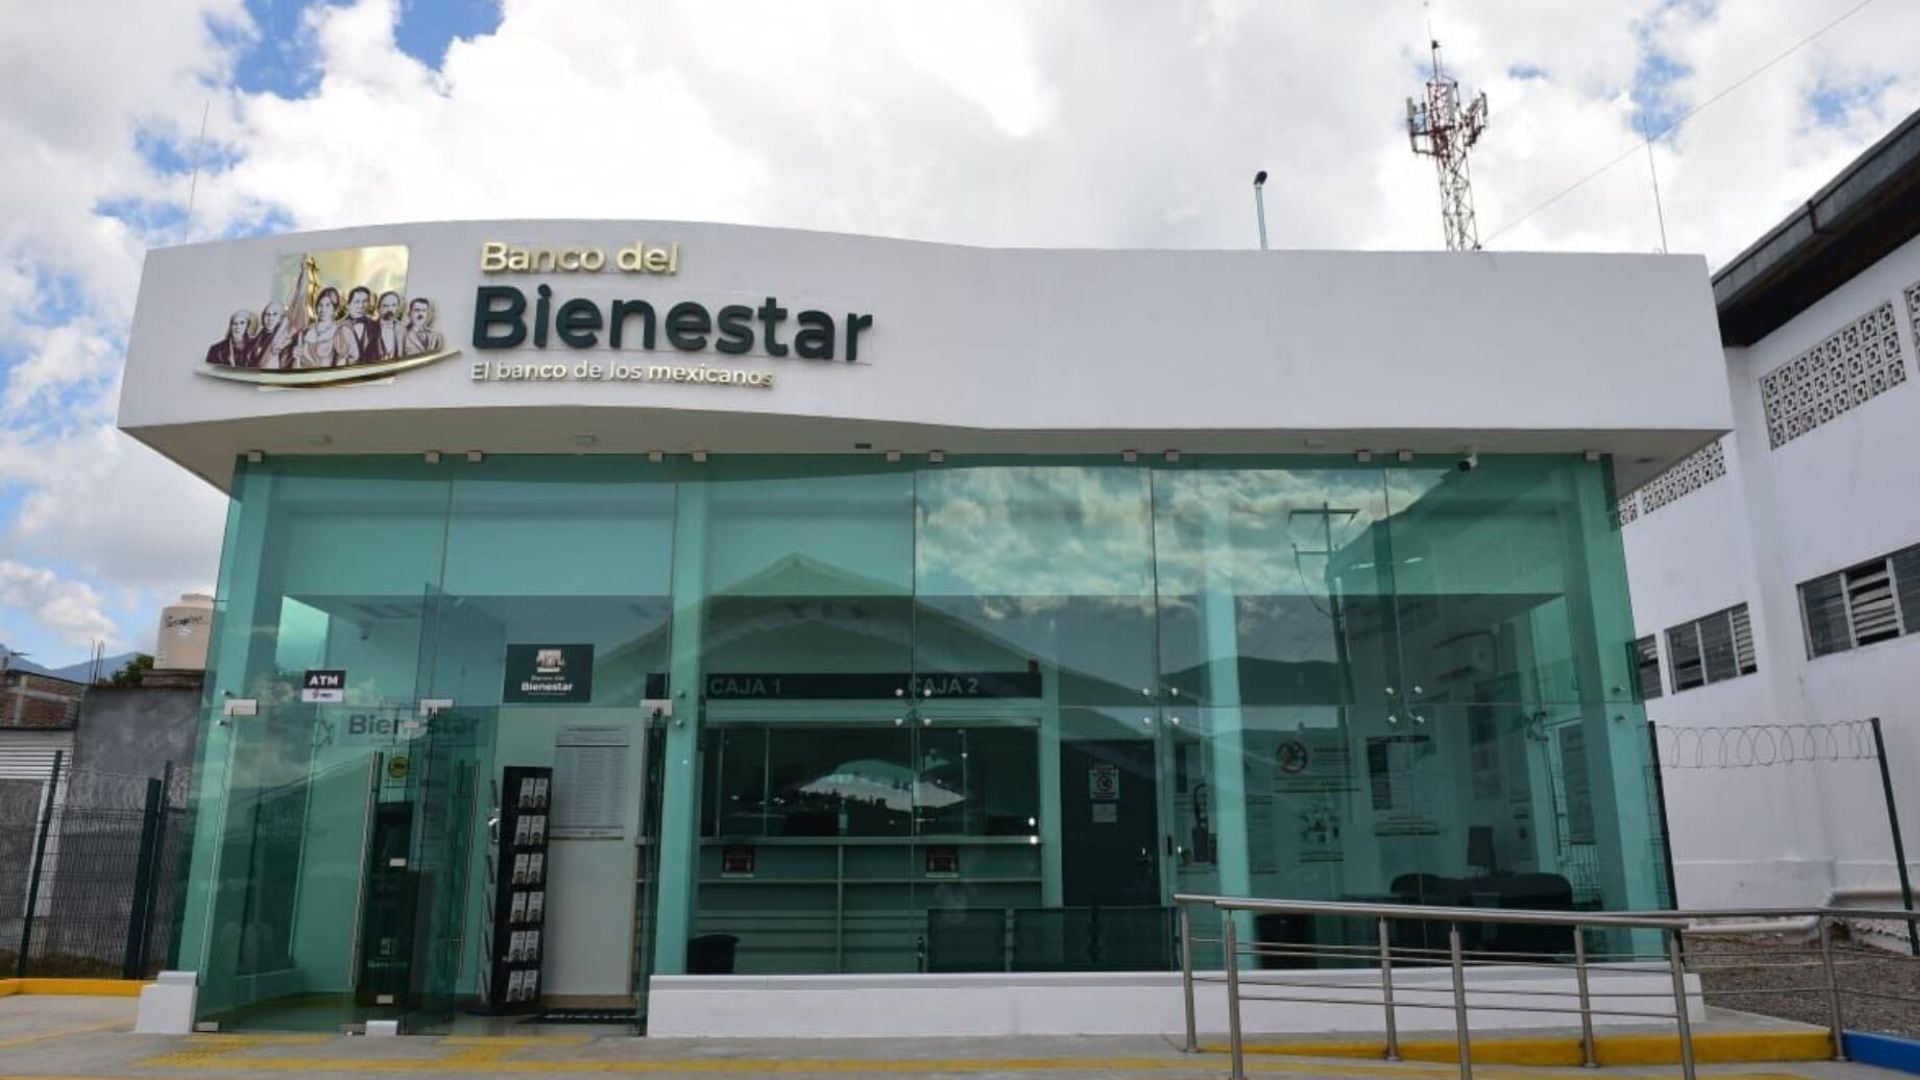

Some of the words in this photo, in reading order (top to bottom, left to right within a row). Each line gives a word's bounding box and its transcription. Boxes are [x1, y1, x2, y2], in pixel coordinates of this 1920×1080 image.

[480, 241, 606, 274] Banco
[615, 242, 679, 275] del
[472, 283, 874, 362] Bienestar
[470, 360, 491, 381] El
[497, 361, 567, 380] banco
[573, 359, 603, 379] de
[609, 361, 643, 380] los
[648, 363, 774, 387] mexicanos
[309, 675, 339, 686] ATM
[521, 682, 573, 692] Bienestar
[710, 678, 766, 695] CAJA
[775, 678, 781, 695] 1
[907, 678, 962, 694] CAJA
[967, 678, 978, 693] 2
